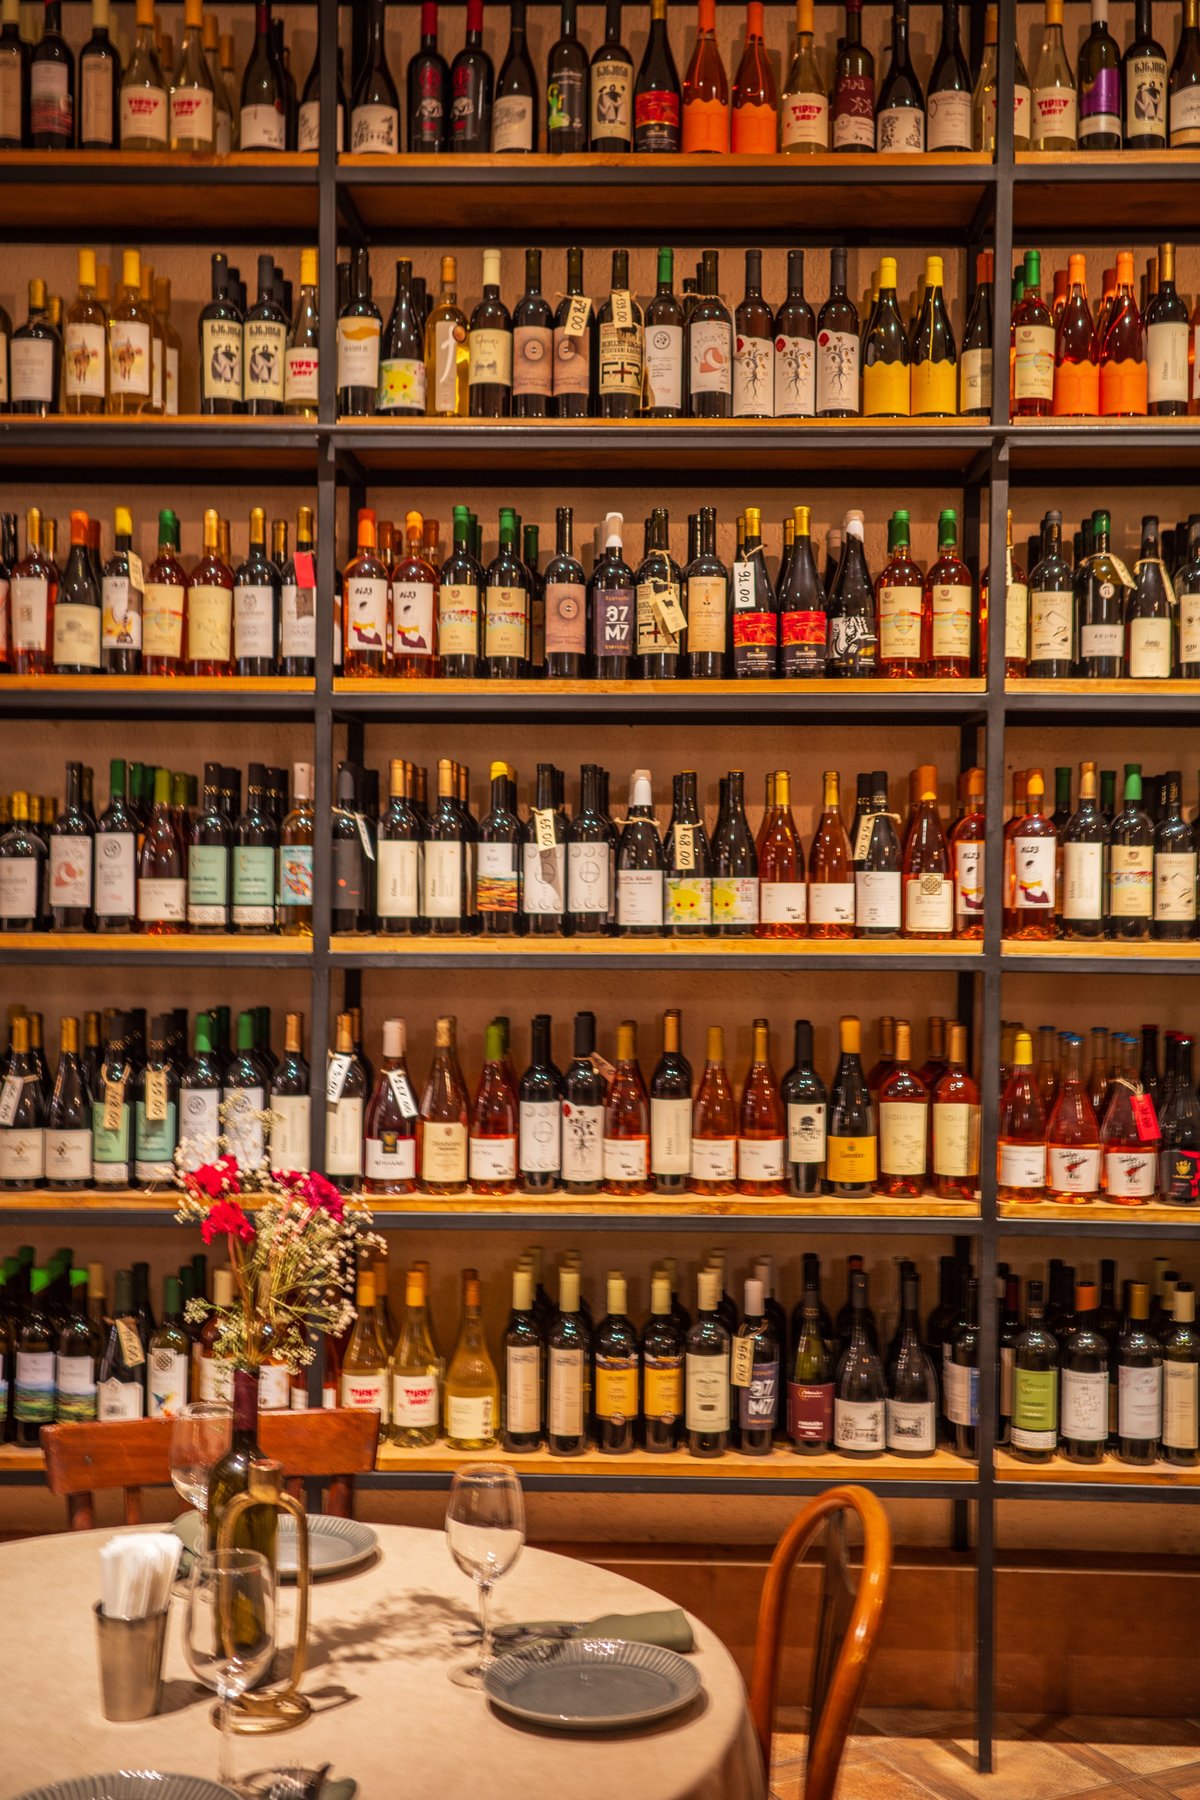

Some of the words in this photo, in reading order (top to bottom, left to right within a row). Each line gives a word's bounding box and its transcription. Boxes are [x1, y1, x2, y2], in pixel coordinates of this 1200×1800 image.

[1037, 99, 1070, 110] TIPSY
[738, 571, 751, 603] 91.00
[605, 624, 629, 641] M7
[539, 818, 553, 848] 65.00
[748, 1398, 774, 1415] M7
